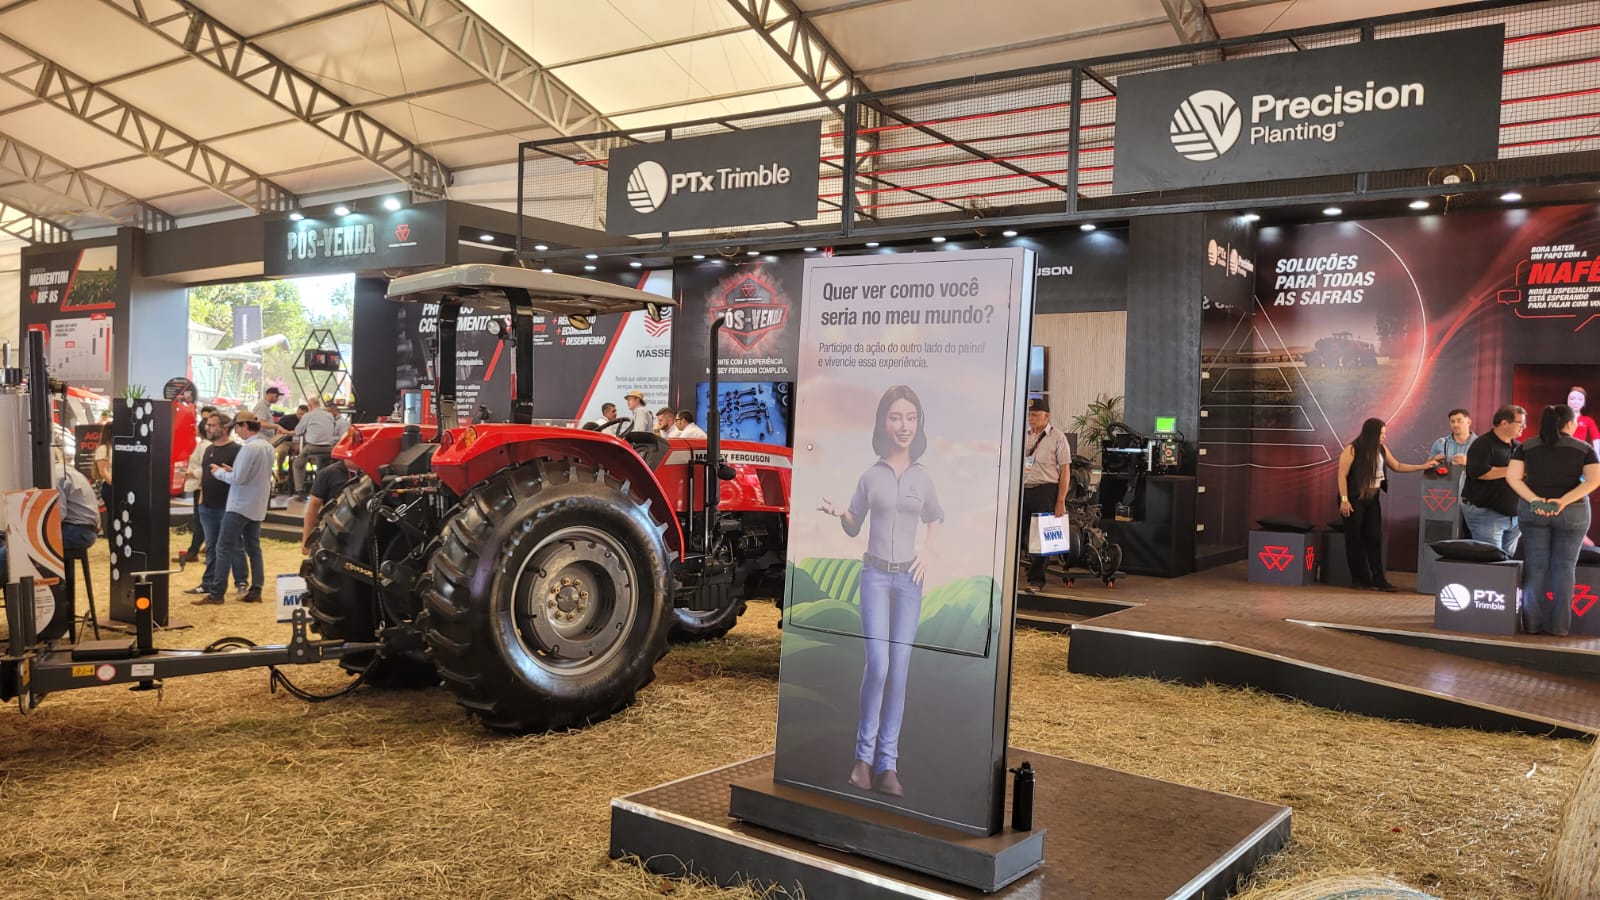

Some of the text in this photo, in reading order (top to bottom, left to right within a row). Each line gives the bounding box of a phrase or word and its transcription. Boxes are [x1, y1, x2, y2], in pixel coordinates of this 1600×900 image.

[1251, 81, 1424, 124] Precision
[671, 162, 791, 195] PTx Trimble
[287, 223, 376, 260] PÓS-VENDA
[1552, 244, 1575, 252] BATER
[1275, 252, 1358, 275] SOLUÇÕES
[29, 270, 70, 287] MOMENTUM
[1275, 271, 1376, 290] PARA TODAS
[823, 276, 979, 302] Quer ver como você
[1273, 289, 1364, 306] AS SAFRAS
[1528, 293, 1589, 302] ESTÁ ESPERANDO
[821, 304, 994, 326] seria no meu mundo?
[566, 336, 606, 346] DESEMPENHO
[636, 349, 671, 358] MASSE
[819, 342, 986, 357] Participe da ação do outro lado do painel
[749, 356, 783, 365] EXPERIÊNCIA
[817, 356, 928, 369] e vivencie essa experiência.
[731, 454, 771, 463] FERGUSON
[283, 595, 302, 606] MW
[1473, 590, 1505, 602] PTx
[1474, 601, 1505, 611] Trimble
